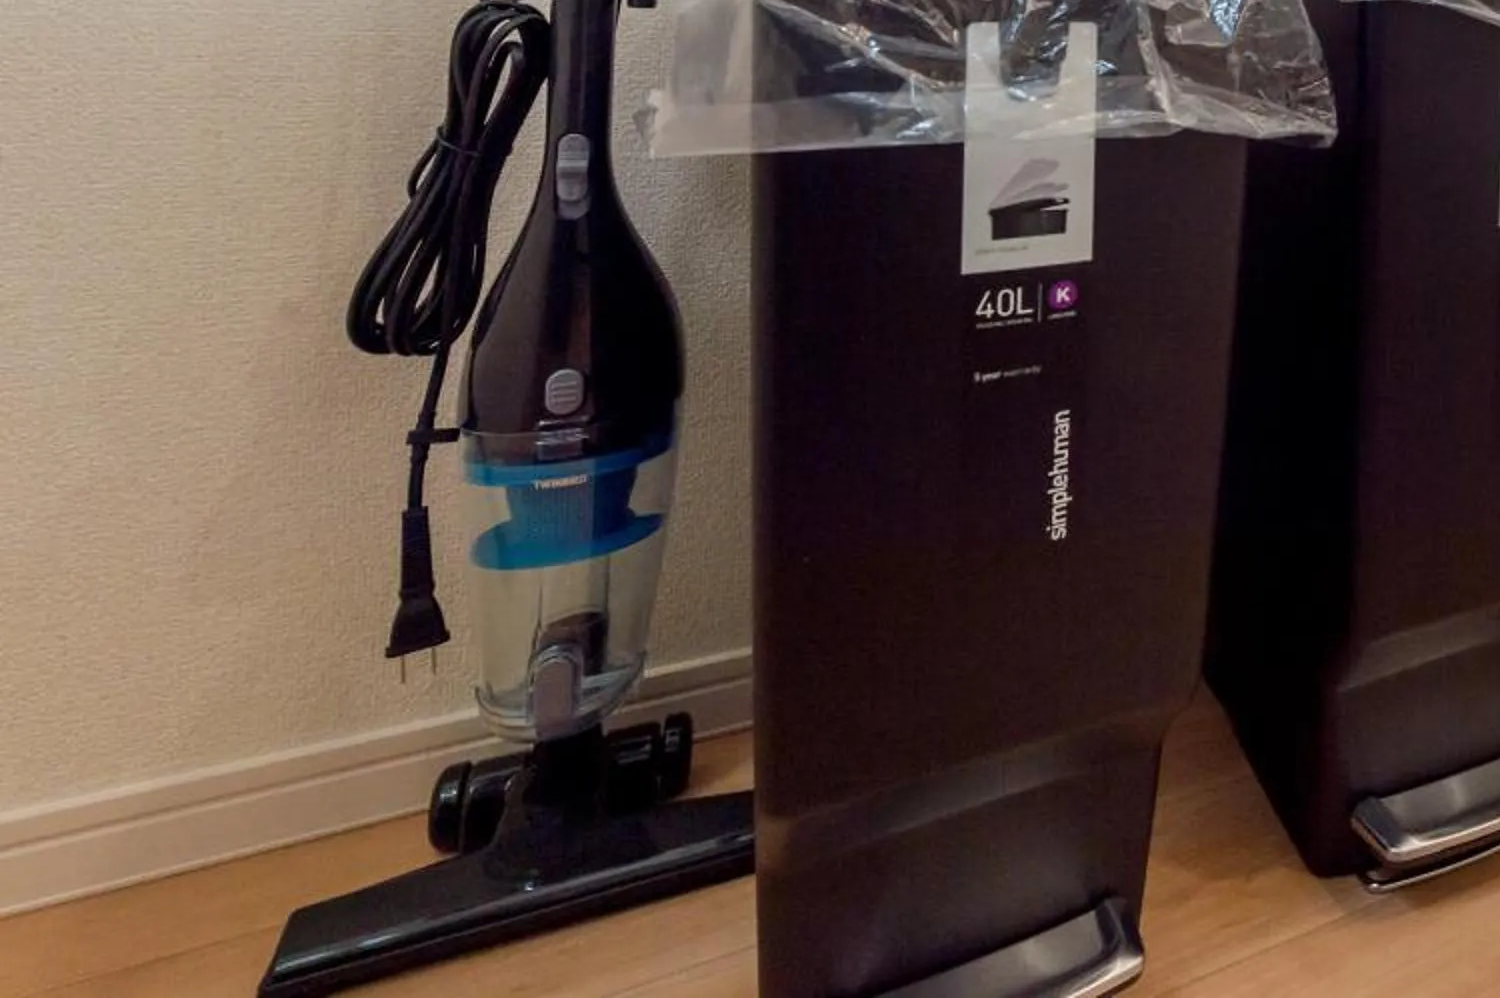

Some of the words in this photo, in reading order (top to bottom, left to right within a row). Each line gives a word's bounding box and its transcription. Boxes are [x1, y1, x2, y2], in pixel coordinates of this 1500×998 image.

[975, 286, 1034, 319] 40L
[1056, 286, 1072, 304] K
[1045, 408, 1073, 541] simplehuman
